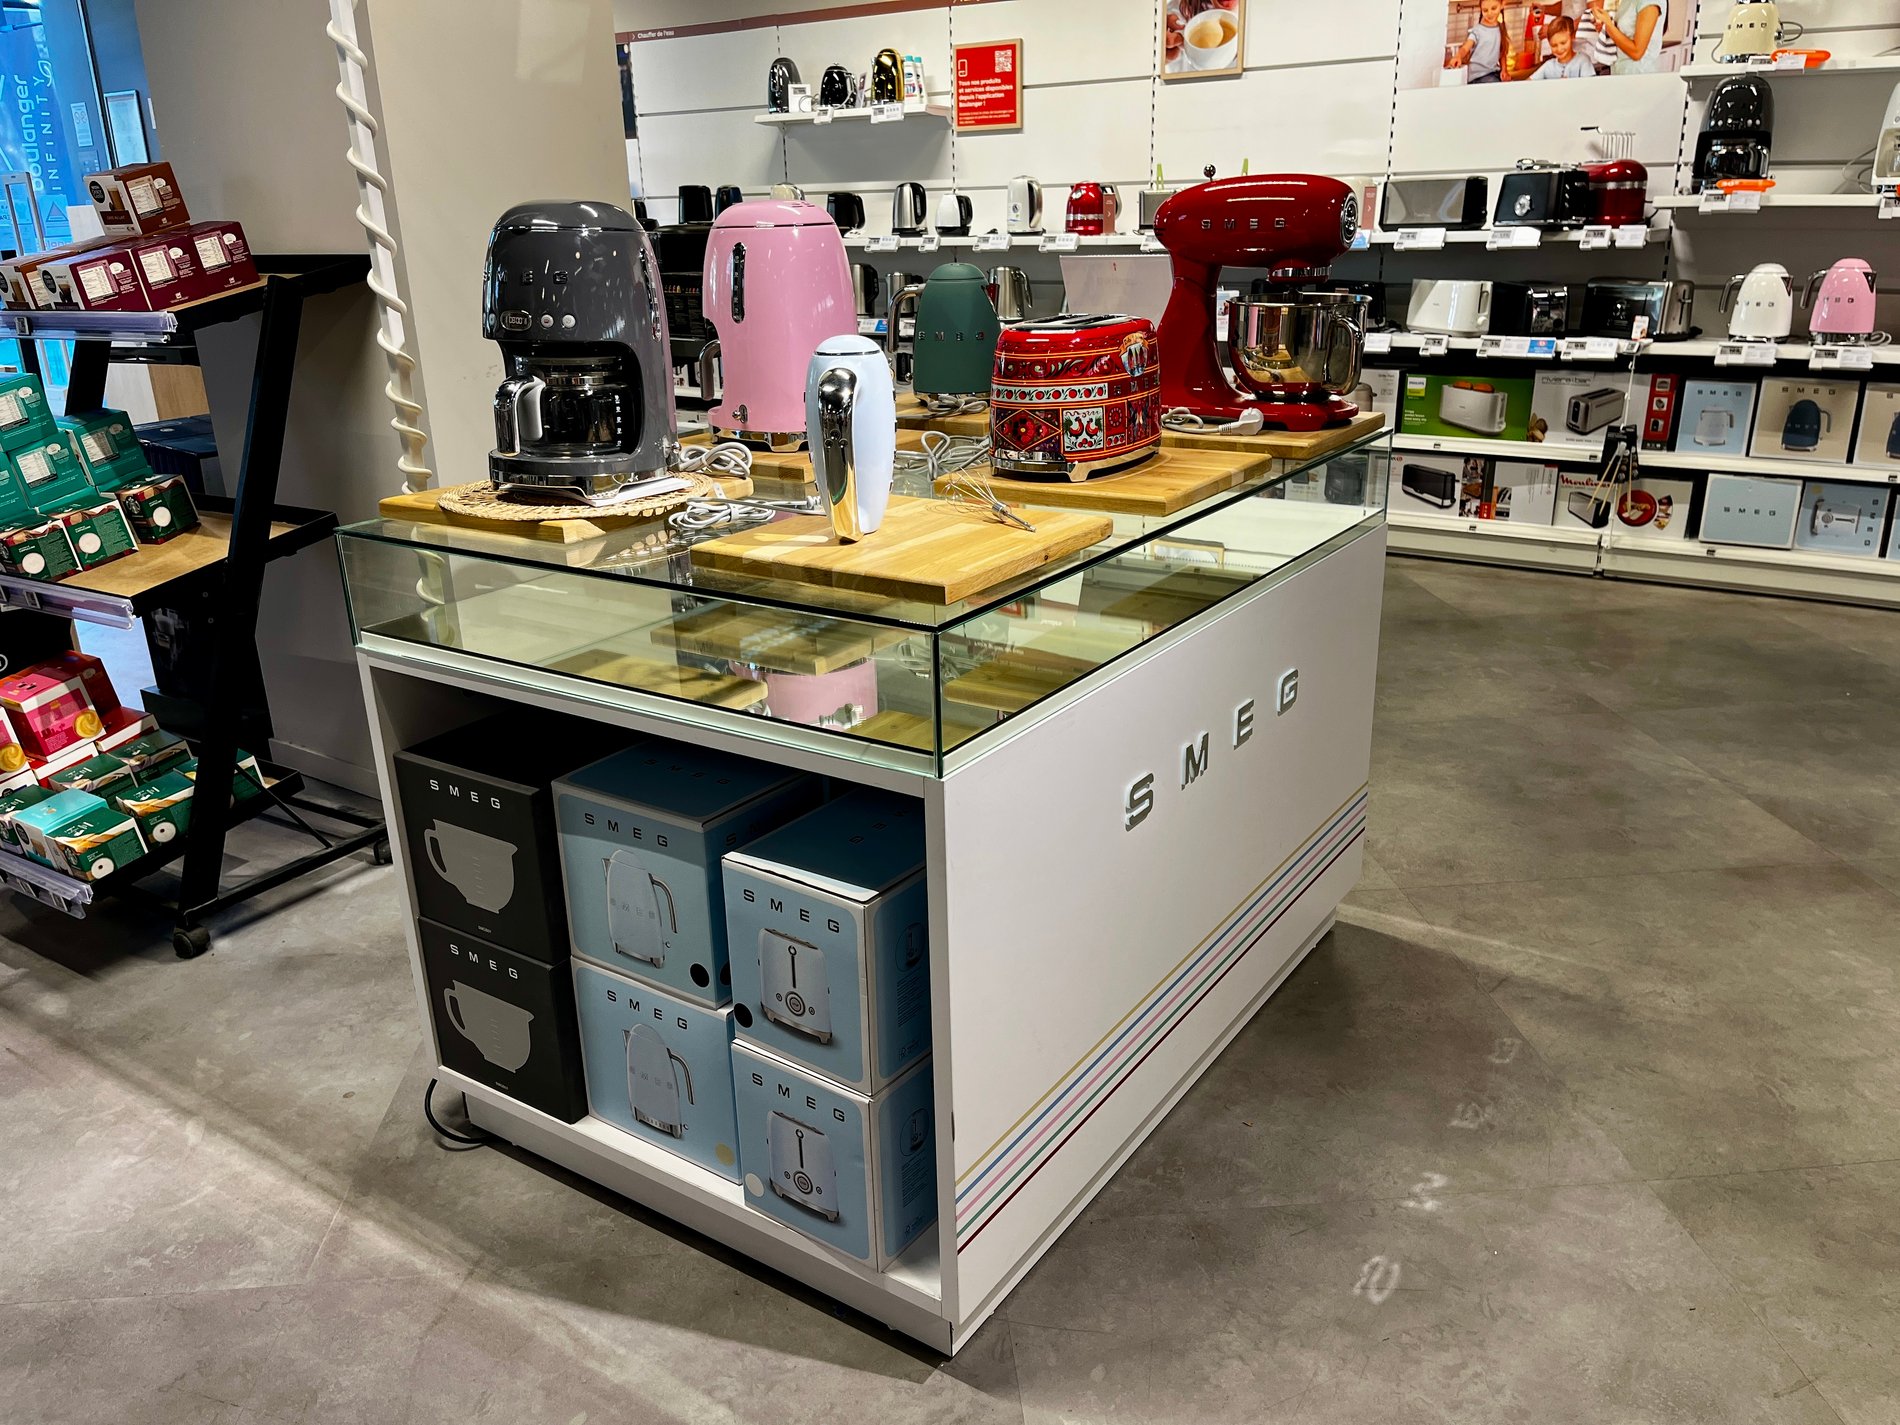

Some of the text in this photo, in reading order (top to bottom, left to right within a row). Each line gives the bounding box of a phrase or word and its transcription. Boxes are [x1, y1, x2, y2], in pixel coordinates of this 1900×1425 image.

[32, 75, 62, 191] INFINITY
[1201, 217, 1286, 230] SMEG
[918, 330, 985, 342] SMEG
[1697, 389, 1742, 398] SMEG
[1782, 386, 1836, 396] SMEG
[1723, 506, 1776, 517] SMEG
[1124, 667, 1299, 832] SMEG
[429, 779, 501, 810] SMEG
[584, 812, 669, 848] SMEG
[743, 888, 841, 934] SMEG
[450, 943, 519, 980] SMEG
[606, 989, 689, 1031] SMEG
[751, 1071, 846, 1123] SMEG
